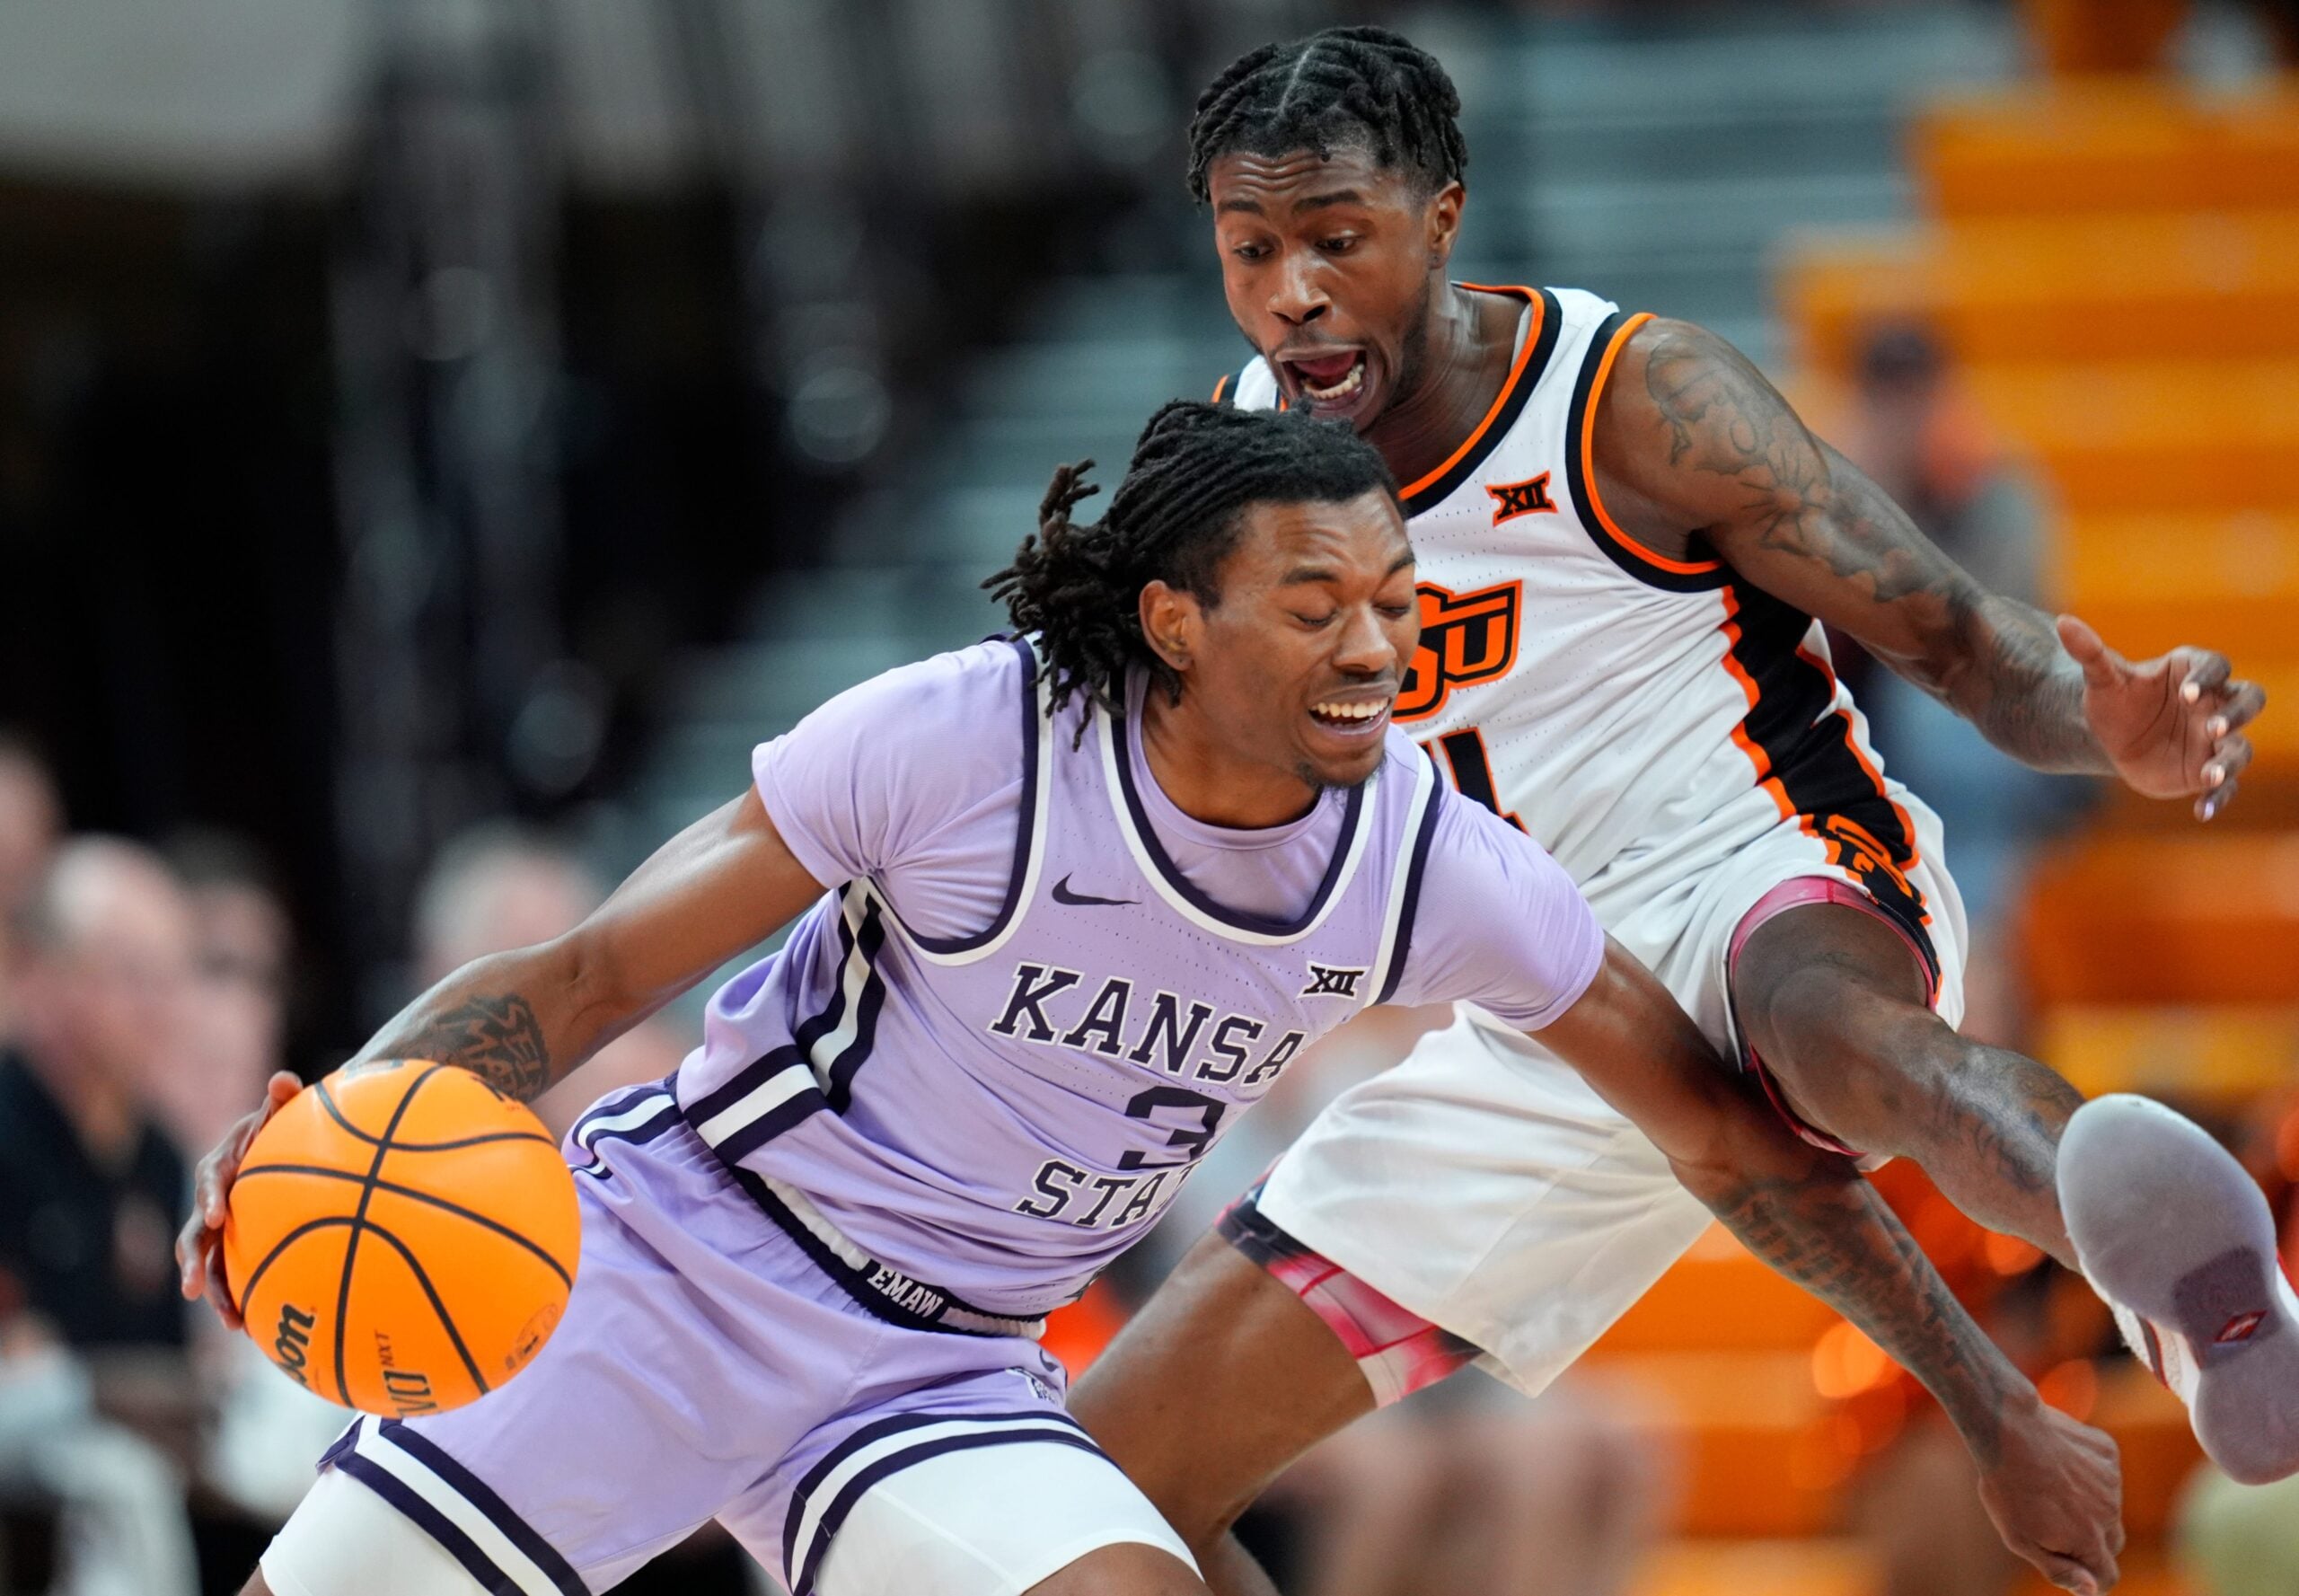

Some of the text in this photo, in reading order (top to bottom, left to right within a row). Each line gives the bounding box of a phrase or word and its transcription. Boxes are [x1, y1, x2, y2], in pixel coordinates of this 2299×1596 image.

[1303, 965, 1366, 999] XII
[990, 963, 1306, 1087] KANSA
[1116, 1085, 1229, 1171] 3
[1015, 1159, 1203, 1228] STA
[866, 1263, 944, 1318] EMAW
[374, 1328, 394, 1368] NXT
